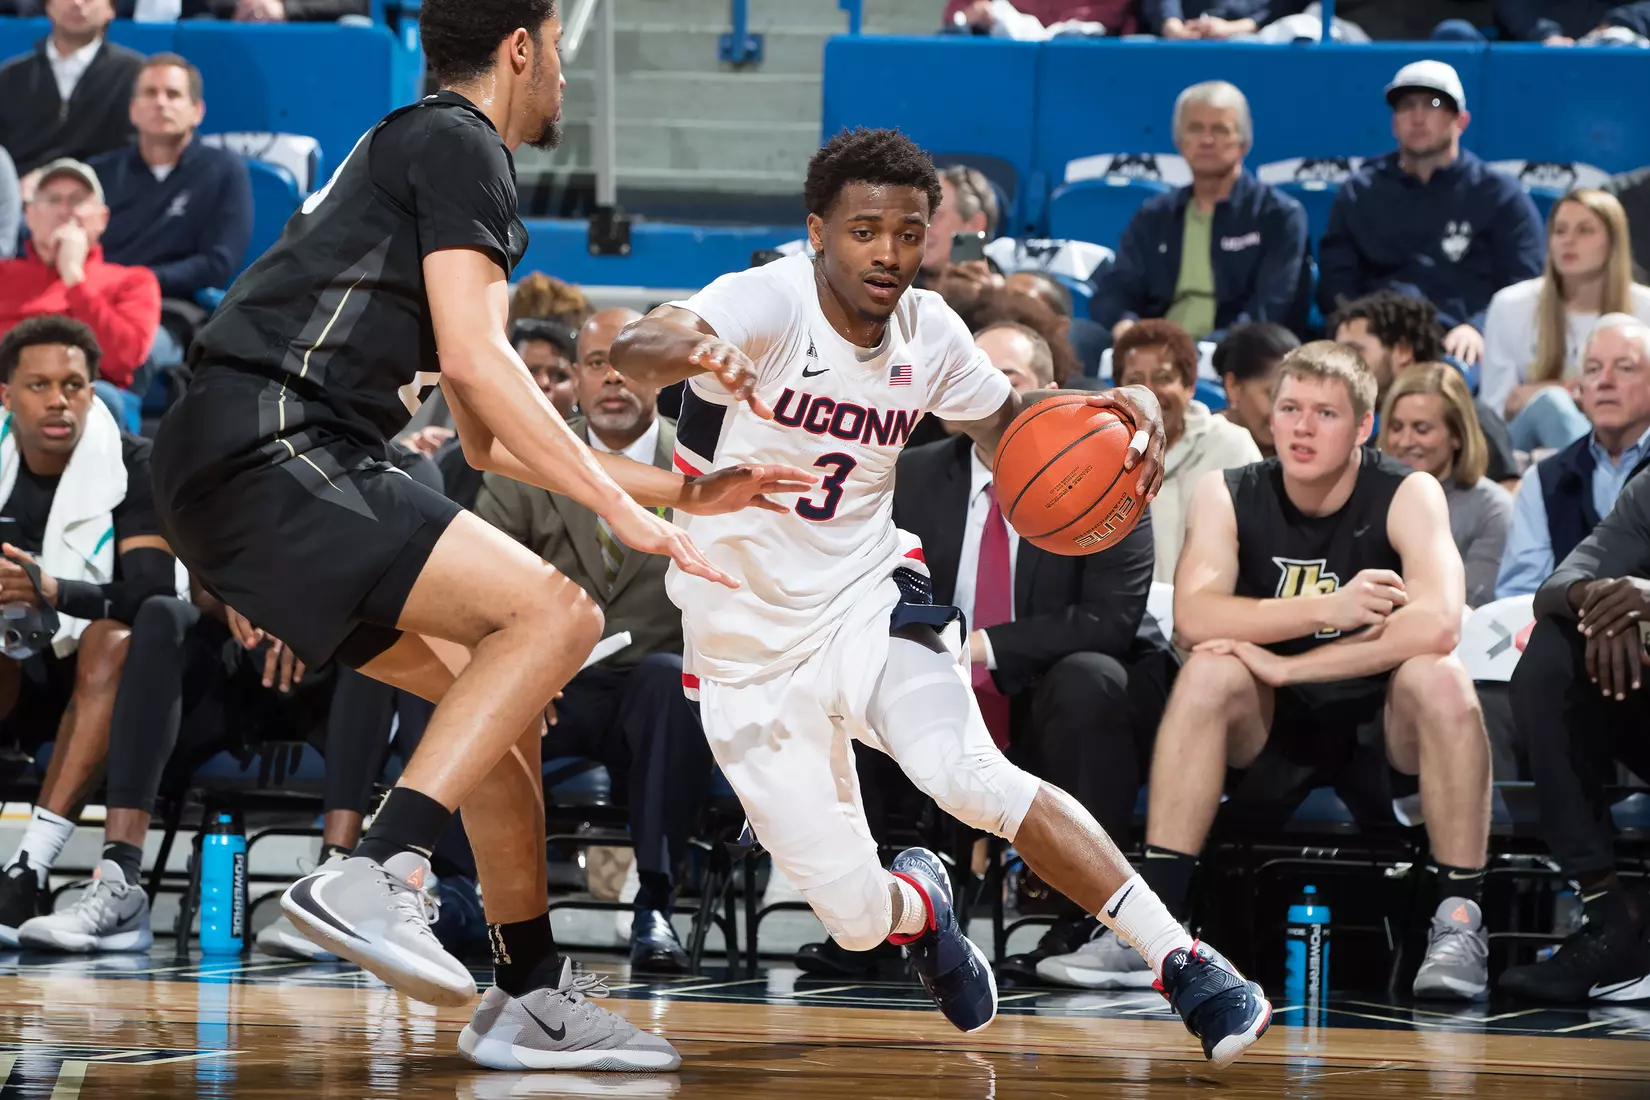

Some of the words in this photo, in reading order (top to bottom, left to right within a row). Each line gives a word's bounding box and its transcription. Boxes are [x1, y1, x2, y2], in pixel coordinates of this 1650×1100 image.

[772, 387, 919, 447] UCONN
[795, 451, 858, 522] 3
[1072, 491, 1127, 541] CHAMPIONSHIP
[1075, 495, 1136, 548] ELITE
[234, 854, 244, 935] POWERADE
